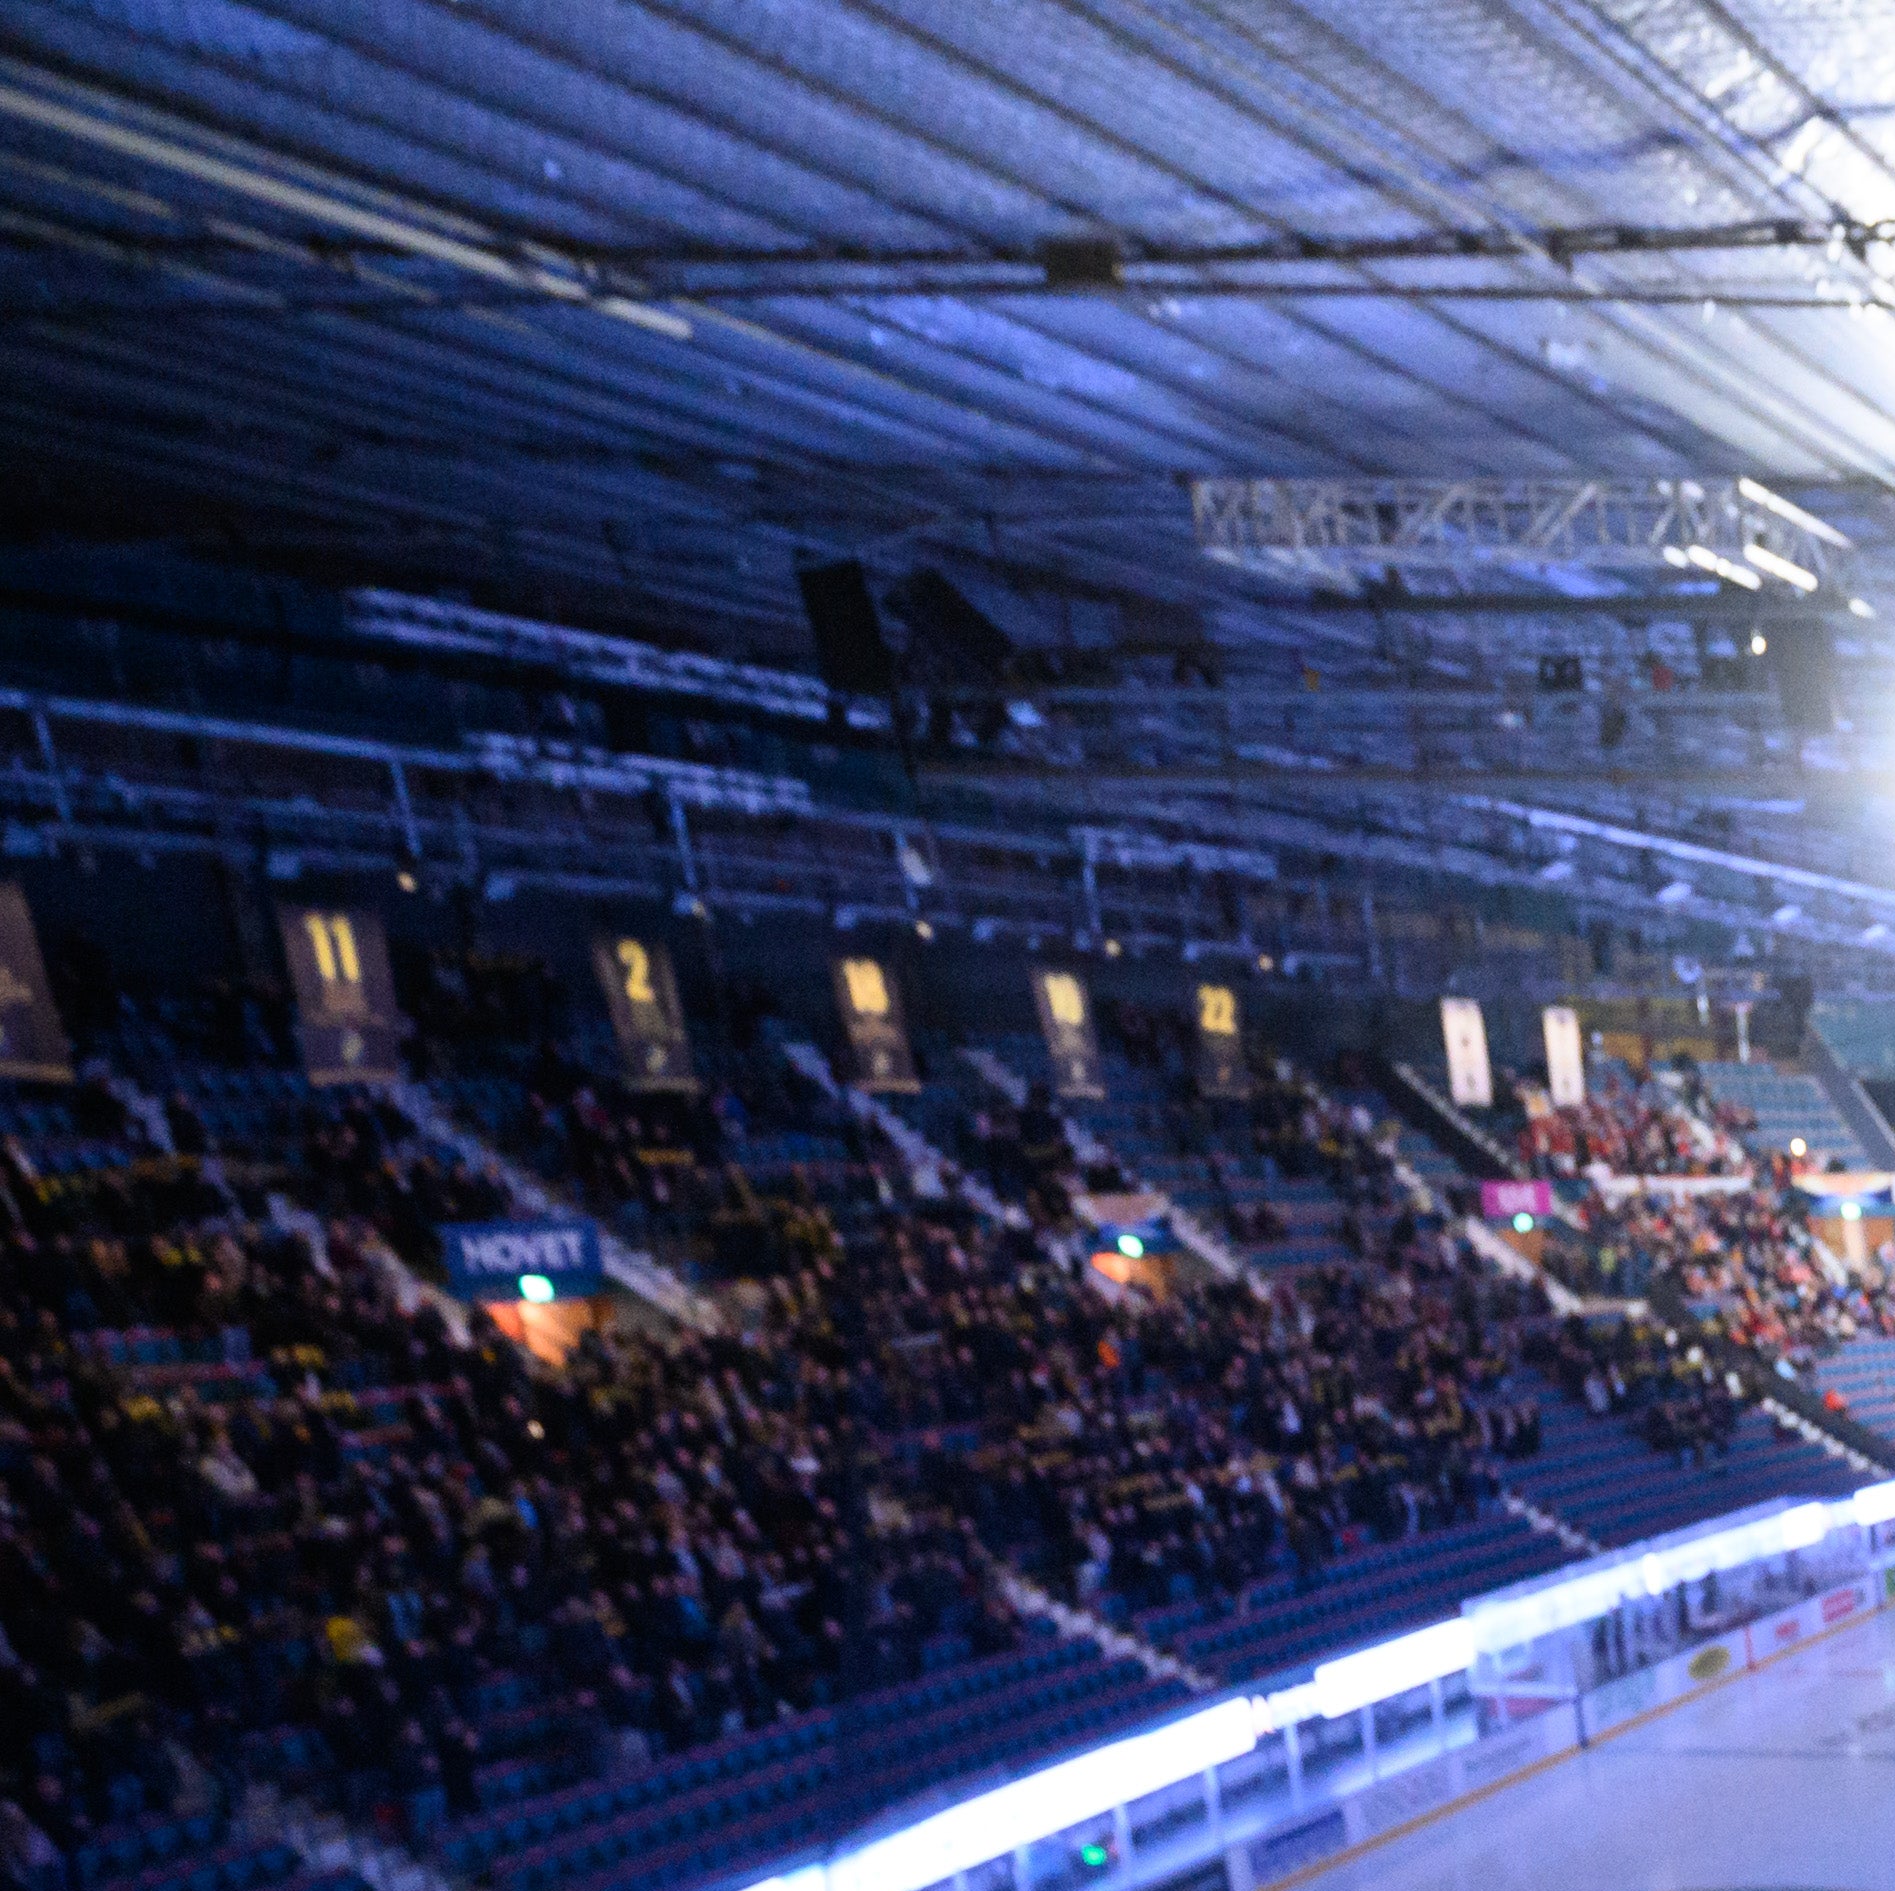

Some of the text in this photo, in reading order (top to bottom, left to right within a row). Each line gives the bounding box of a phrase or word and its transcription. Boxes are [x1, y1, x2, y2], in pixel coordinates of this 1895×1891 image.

[303, 911, 361, 982] 11
[616, 936, 656, 1003] 2
[459, 1229, 584, 1273] HOVET
